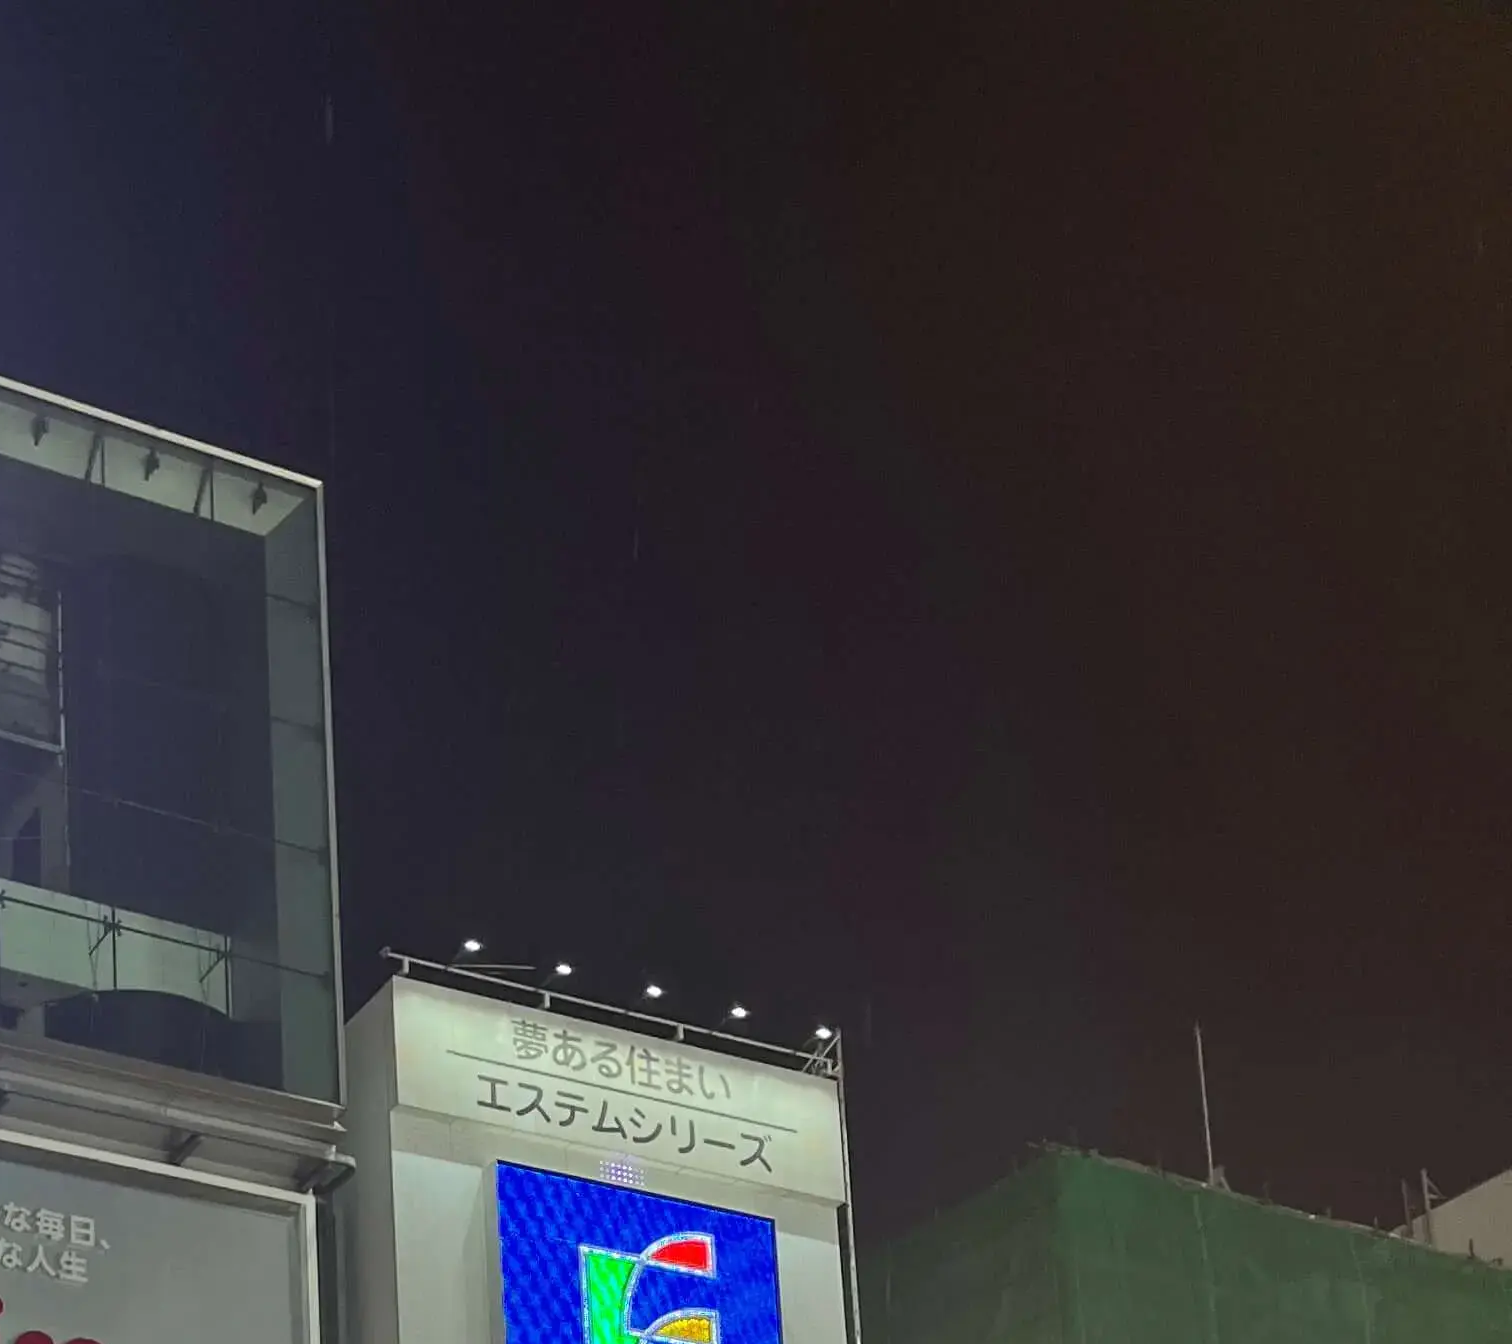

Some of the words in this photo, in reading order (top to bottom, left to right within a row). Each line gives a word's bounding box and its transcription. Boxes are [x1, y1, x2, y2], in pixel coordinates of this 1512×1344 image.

[509, 1017, 732, 1101] 夢ある住まい
[476, 1073, 775, 1173] エステムシリーズ
